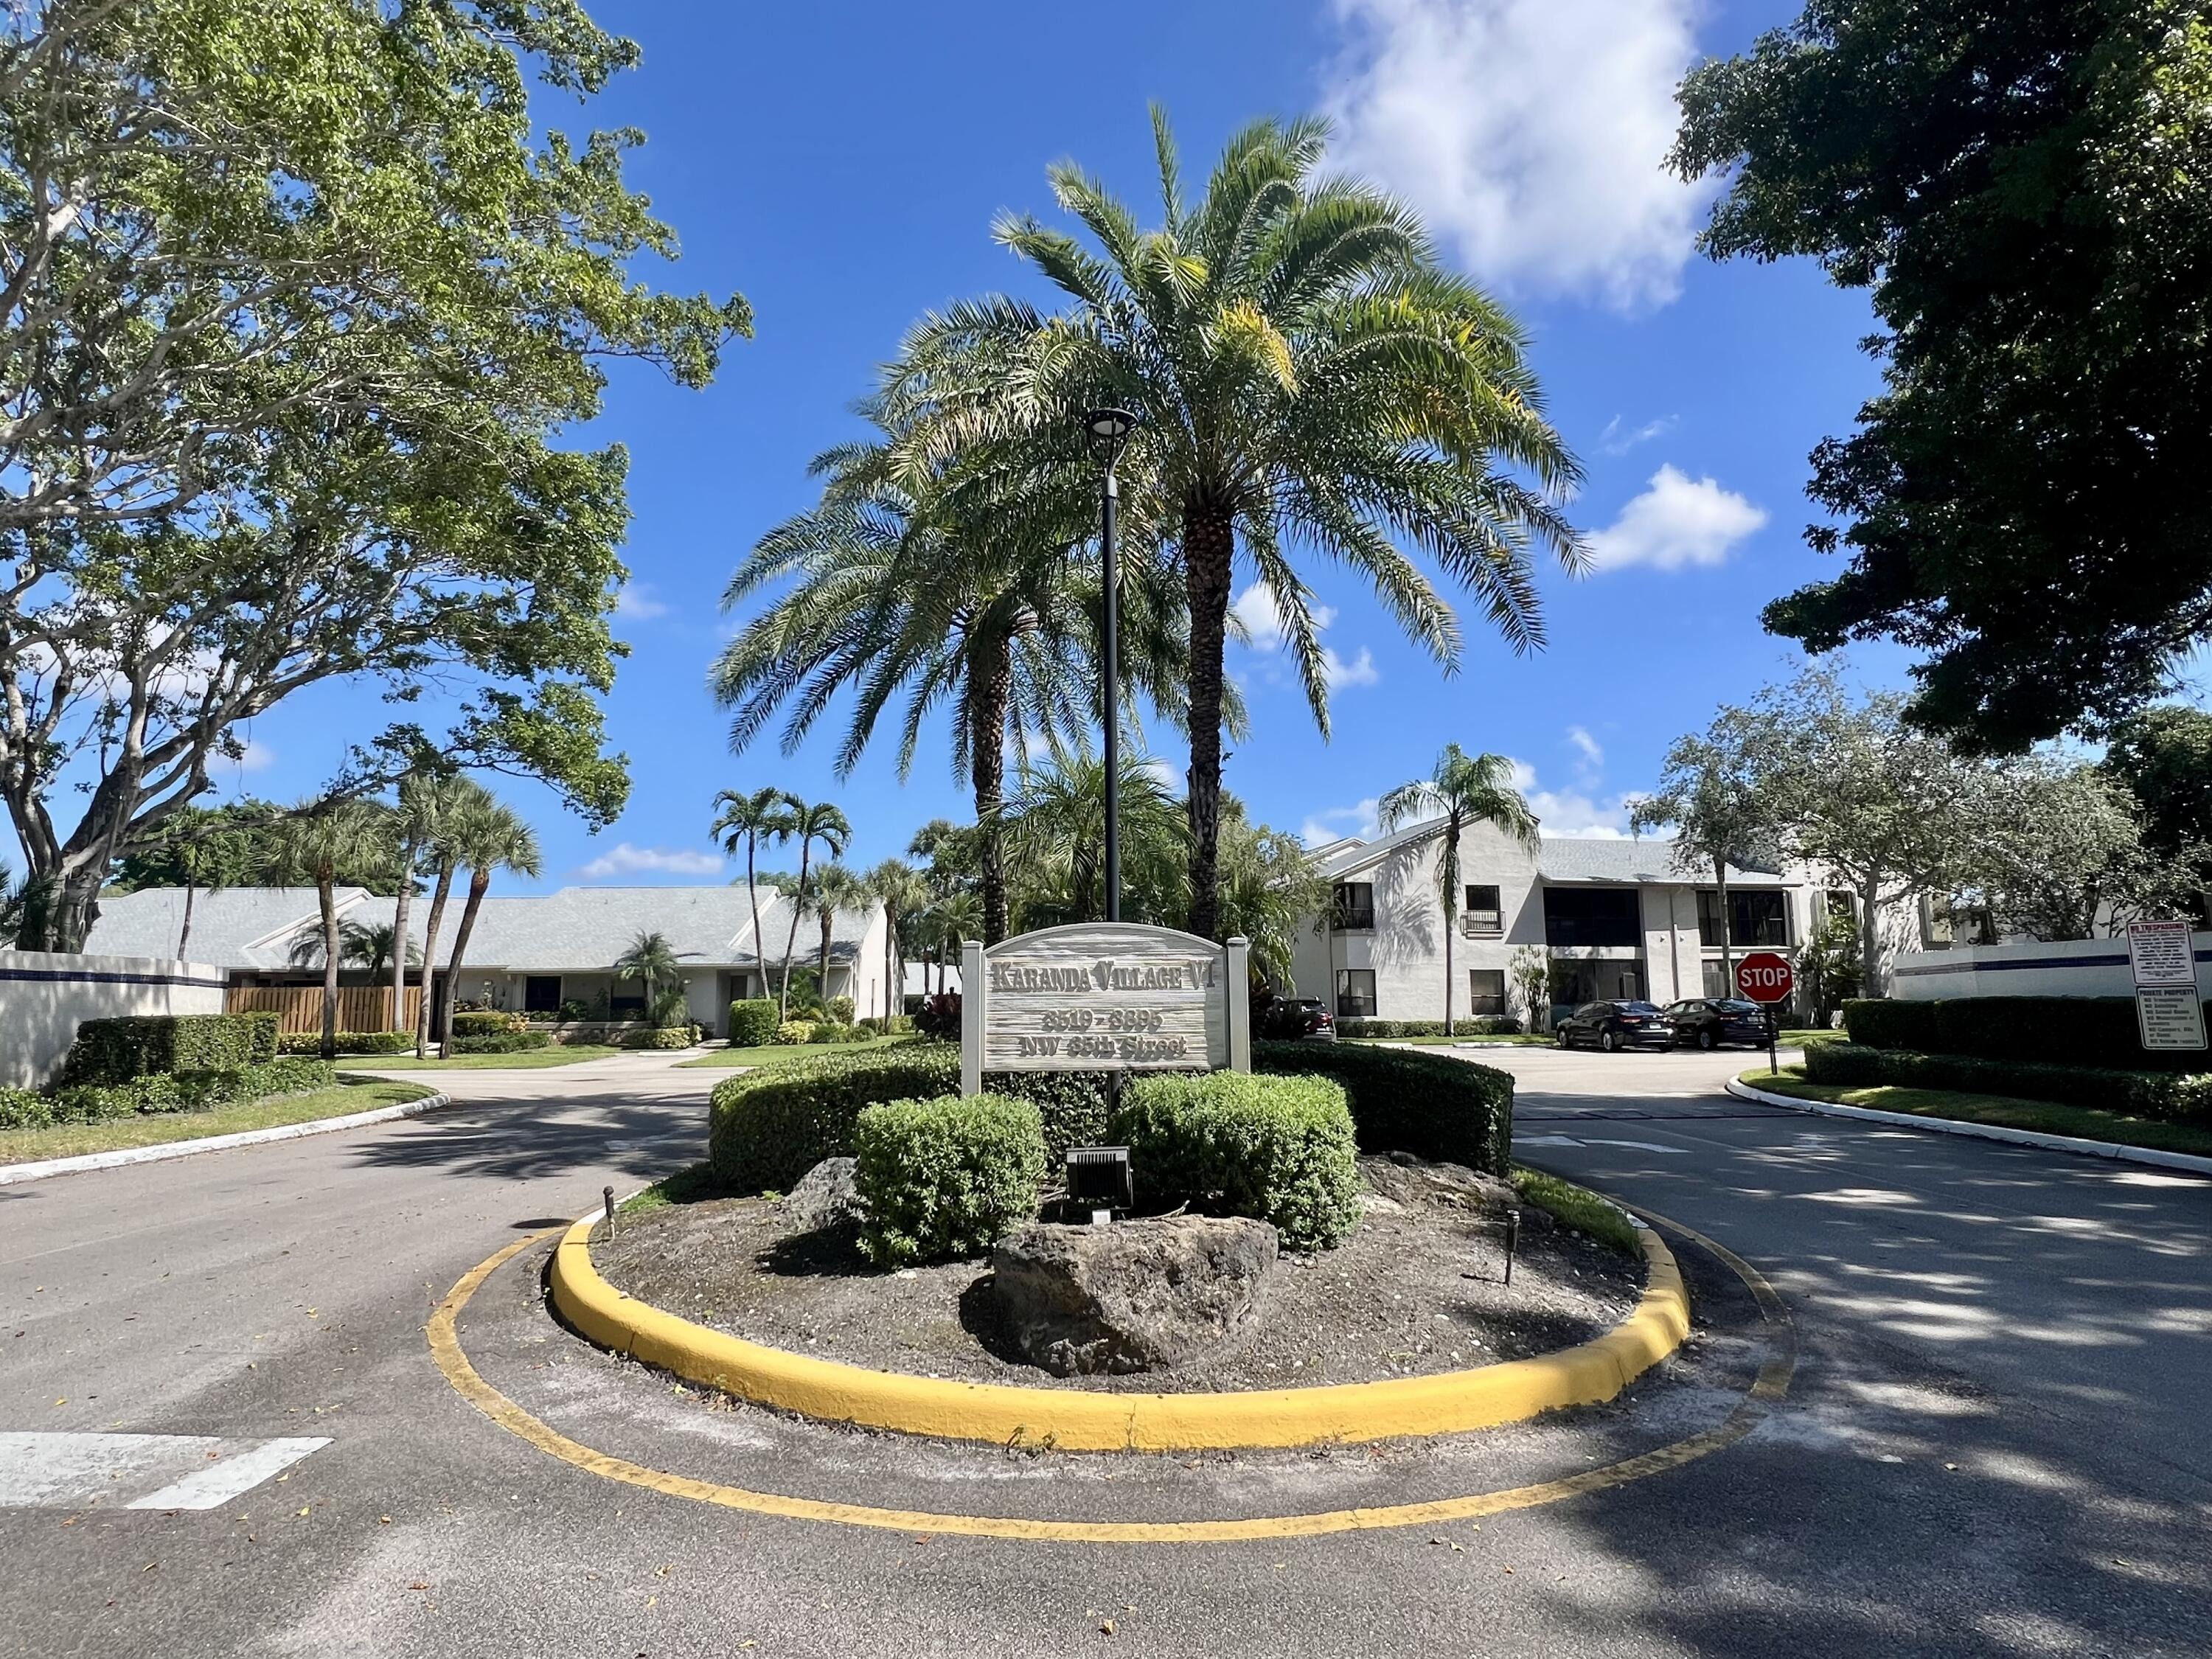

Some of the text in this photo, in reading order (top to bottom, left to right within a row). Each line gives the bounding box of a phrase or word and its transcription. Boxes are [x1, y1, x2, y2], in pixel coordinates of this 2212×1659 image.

[990, 961, 1091, 992] KARANDA
[1093, 960, 1182, 991] VILLAGE
[1741, 967, 1788, 987] STOP
[1018, 1035, 1062, 1057] NW
[1120, 1035, 1188, 1060] Street
